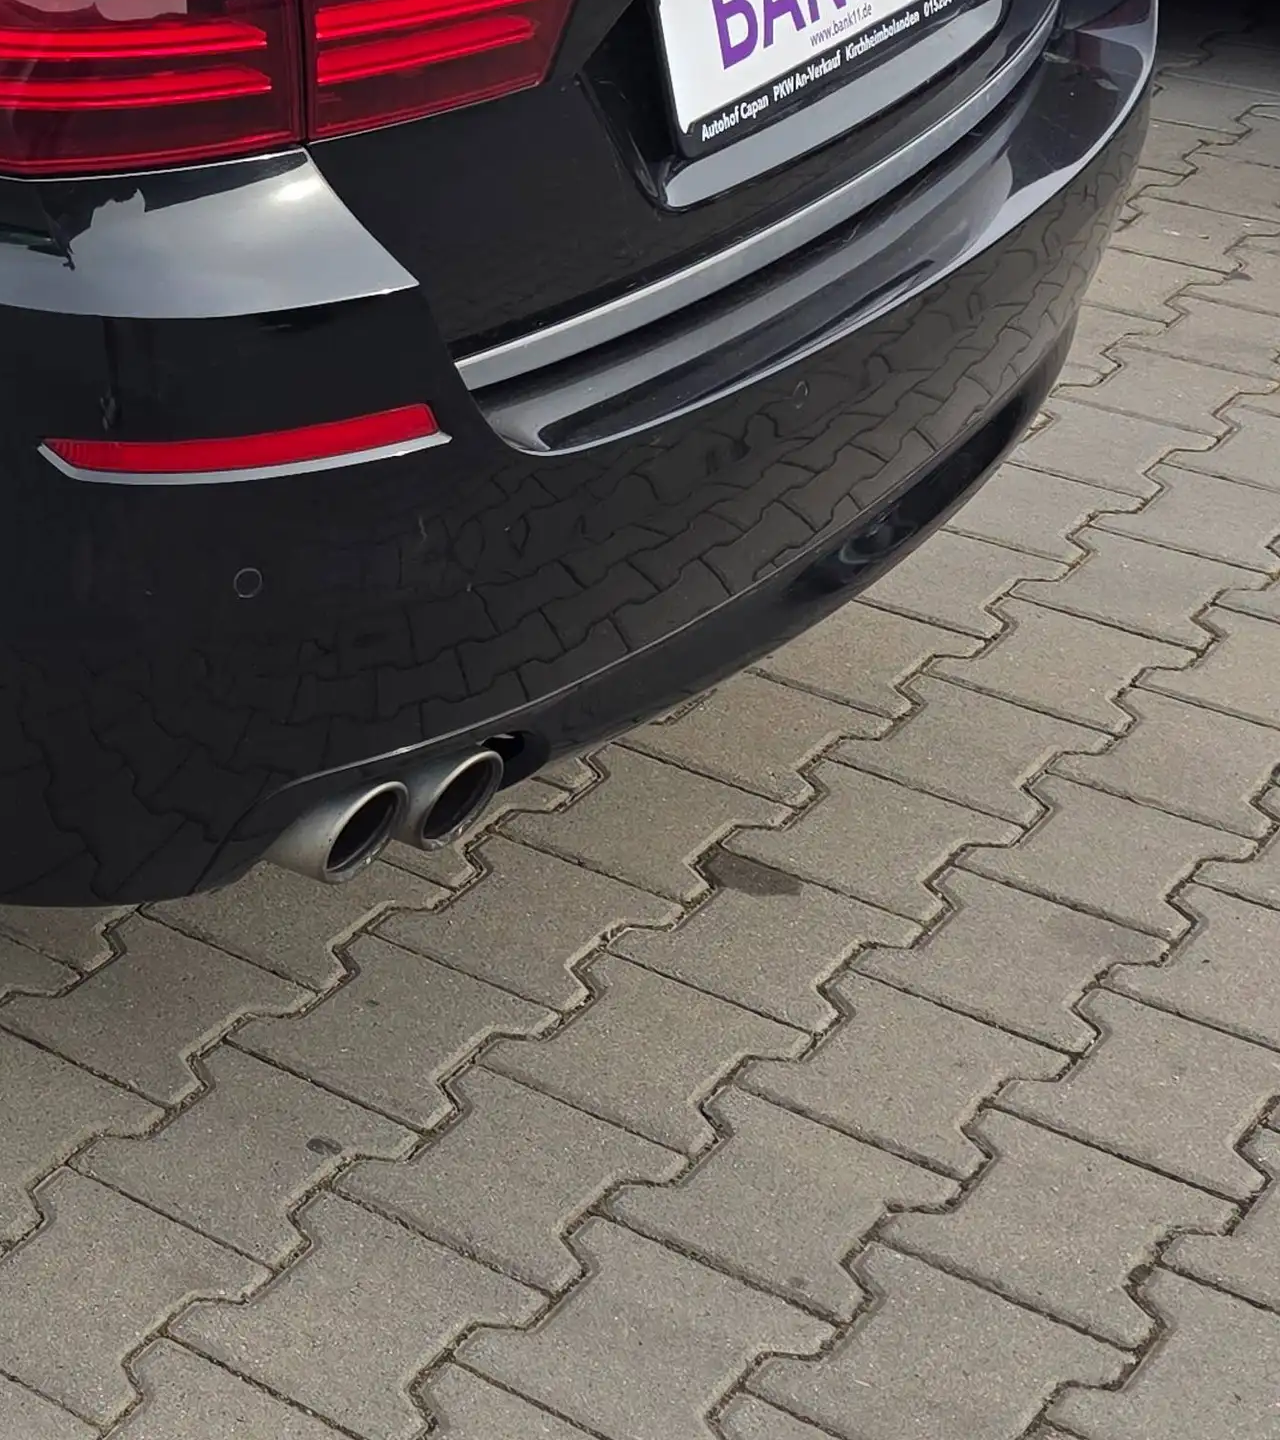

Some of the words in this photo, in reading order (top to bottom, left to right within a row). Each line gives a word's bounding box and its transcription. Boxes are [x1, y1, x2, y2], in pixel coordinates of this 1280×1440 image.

[809, 1, 872, 47] www.bank11.de
[701, 105, 740, 142] Autohof
[740, 94, 769, 119] Capan
[772, 76, 795, 102] PKW
[795, 49, 841, 90] An-Verkauf
[845, 10, 920, 61] Kirchheimbolanden
